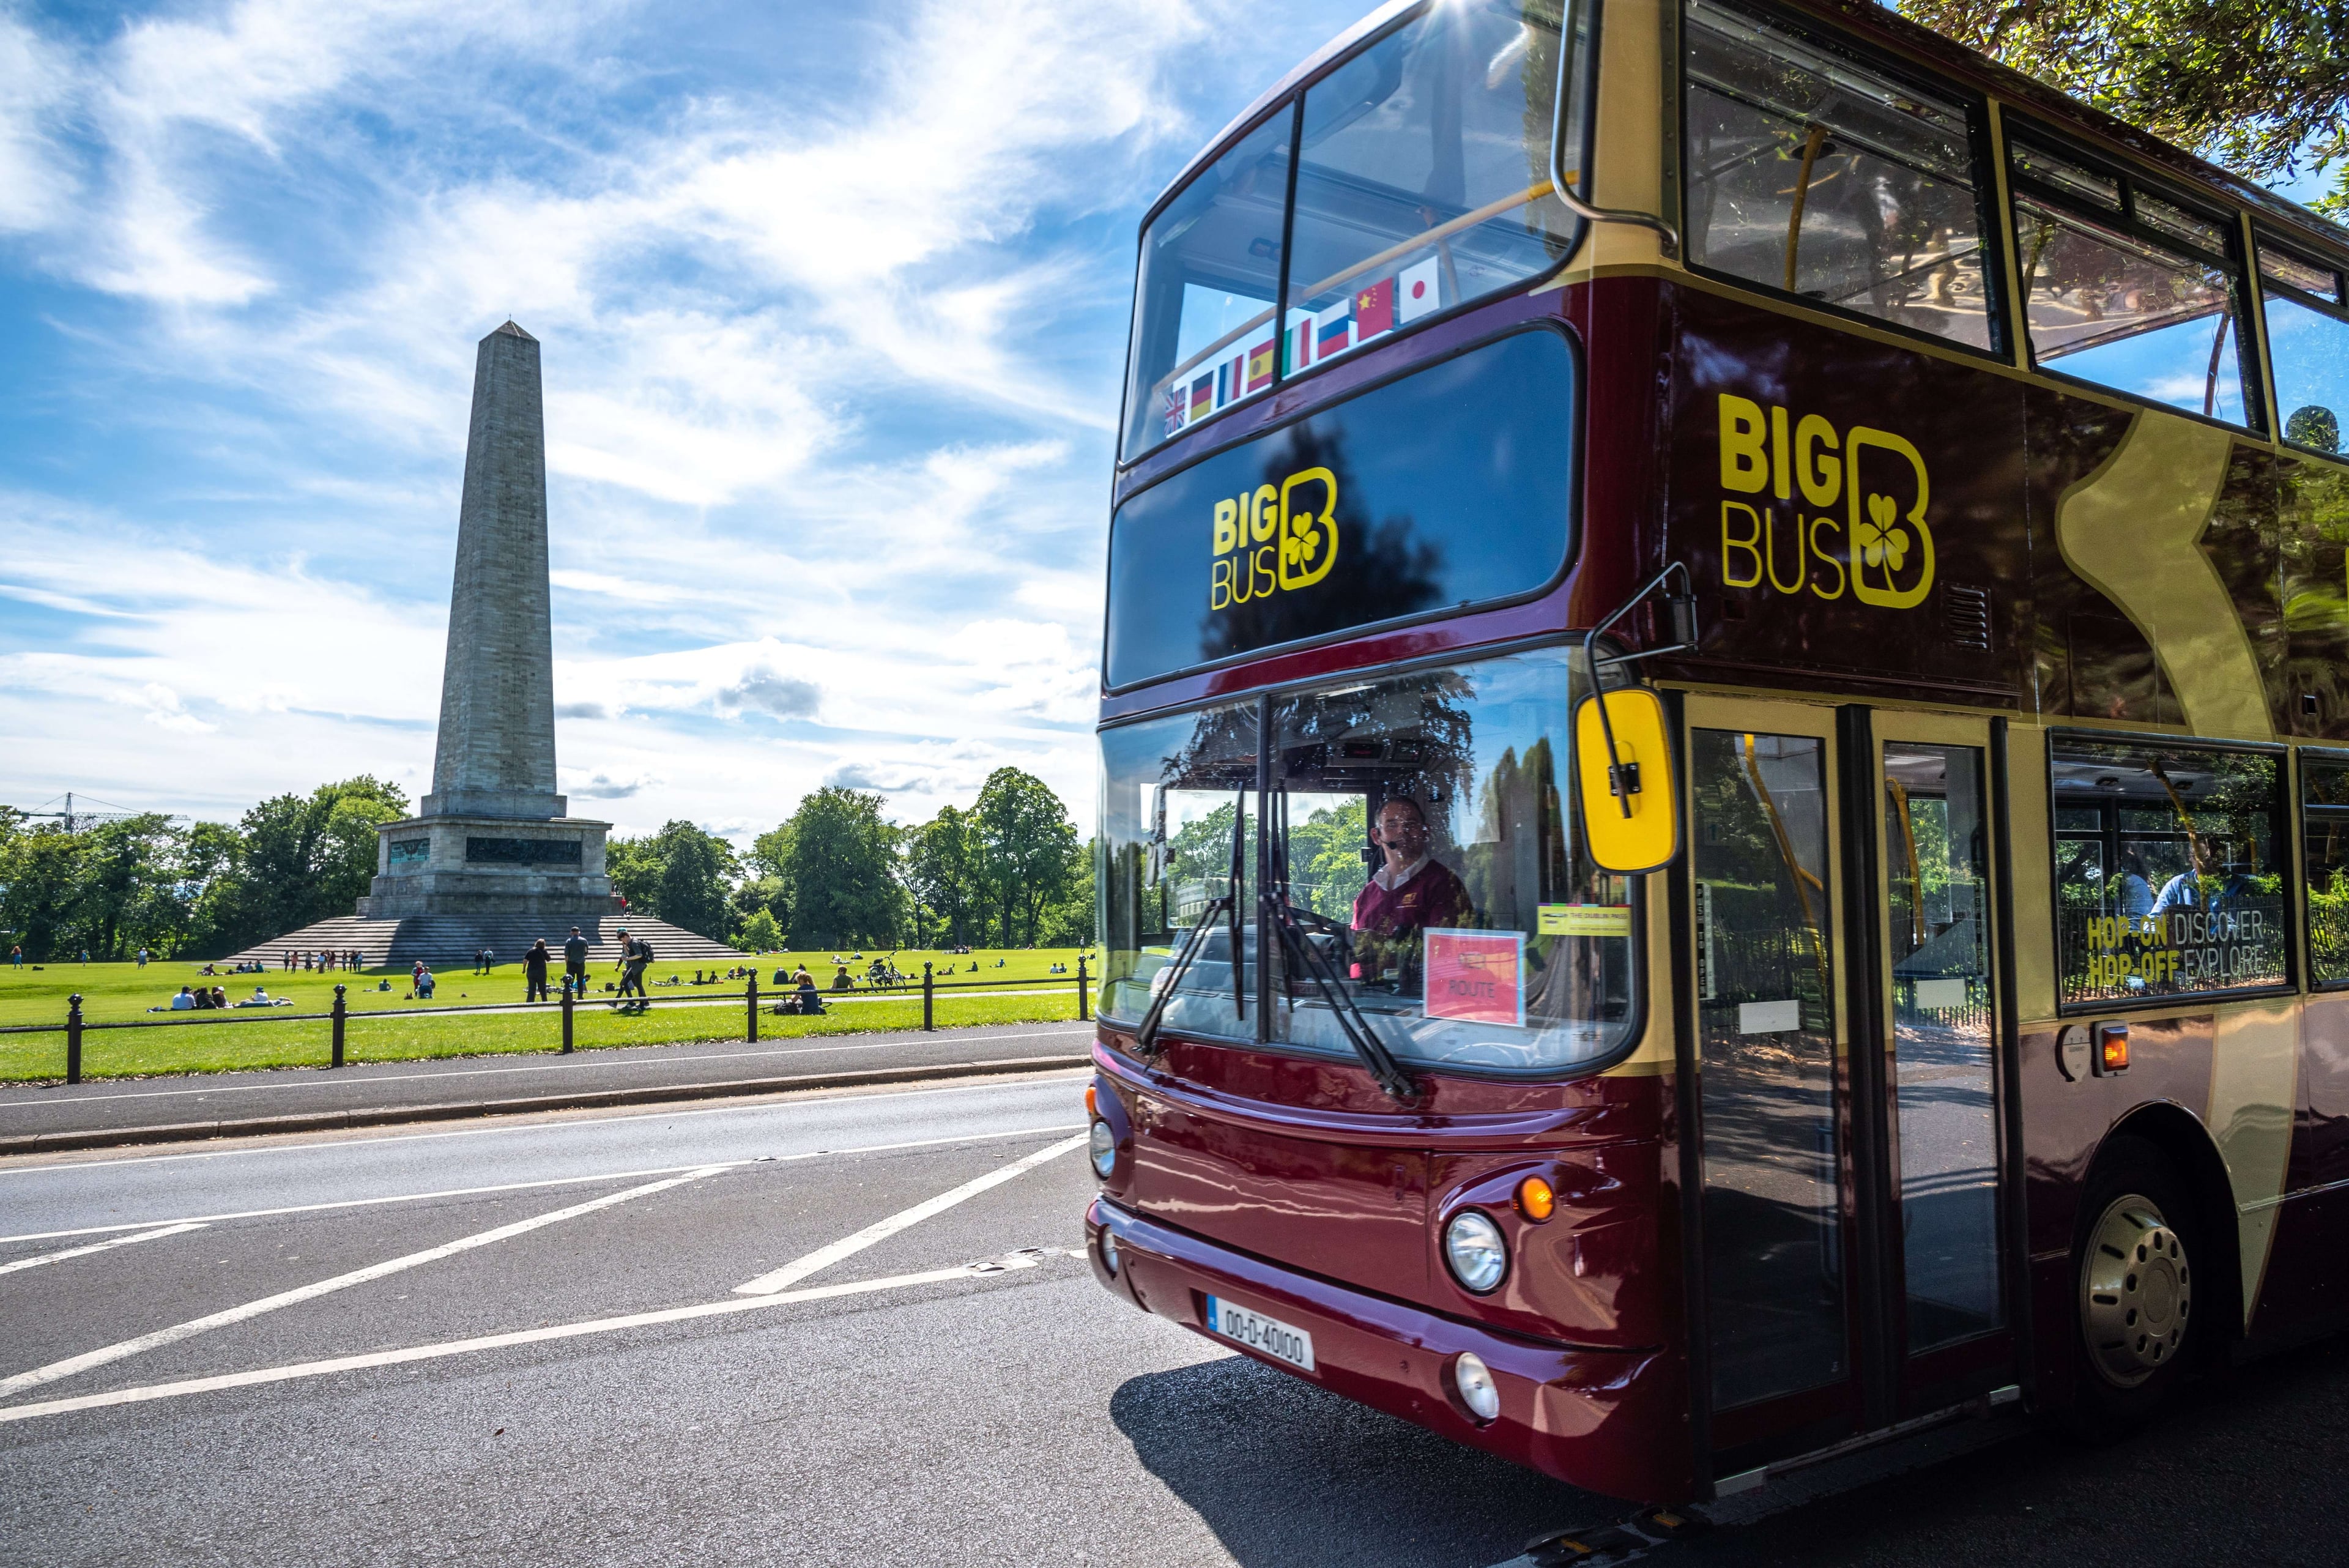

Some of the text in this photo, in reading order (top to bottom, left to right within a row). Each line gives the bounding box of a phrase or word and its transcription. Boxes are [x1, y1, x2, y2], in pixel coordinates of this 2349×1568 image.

[1718, 393, 1841, 507] BIG
[1213, 484, 1278, 556] BIG
[1721, 500, 1845, 600] BUS
[1211, 546, 1277, 610] BUS
[2087, 910, 2263, 949] HOP-ON DISCOVER
[1449, 979, 1495, 998] ROUTE
[2089, 945, 2264, 988] HOP-OFF EXPLORE
